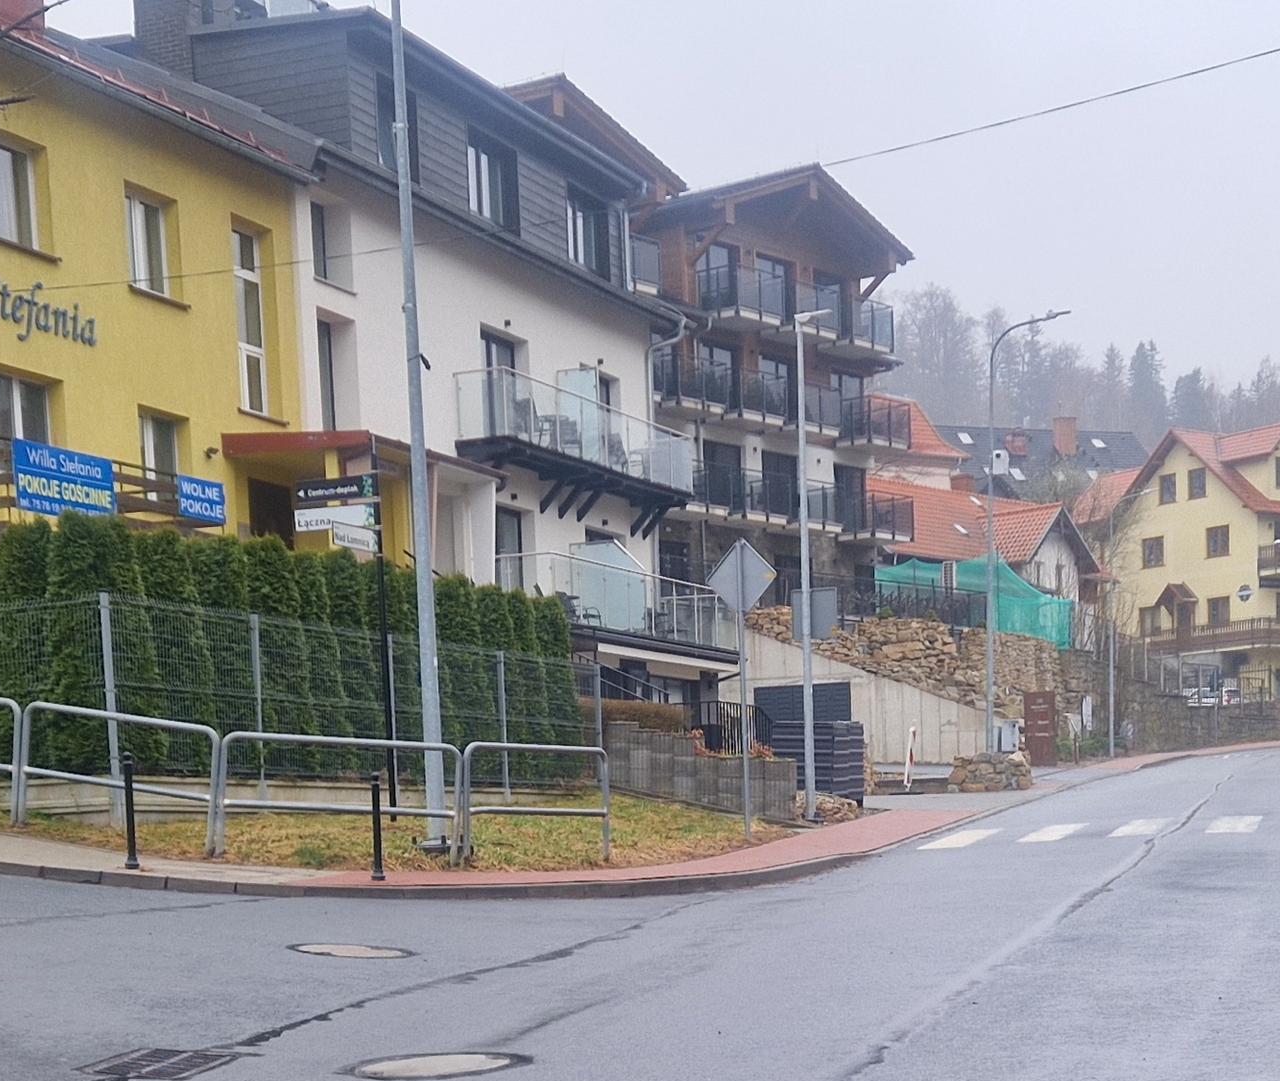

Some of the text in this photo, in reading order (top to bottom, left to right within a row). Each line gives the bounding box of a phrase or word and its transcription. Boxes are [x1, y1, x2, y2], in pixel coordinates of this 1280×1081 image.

[26, 446, 102, 479] Willa Stefania
[18, 472, 112, 509] POKOJE GOŚCINNE
[181, 480, 221, 501] WOLNE
[180, 498, 224, 518] POKOJE
[297, 518, 331, 530] Łączna
